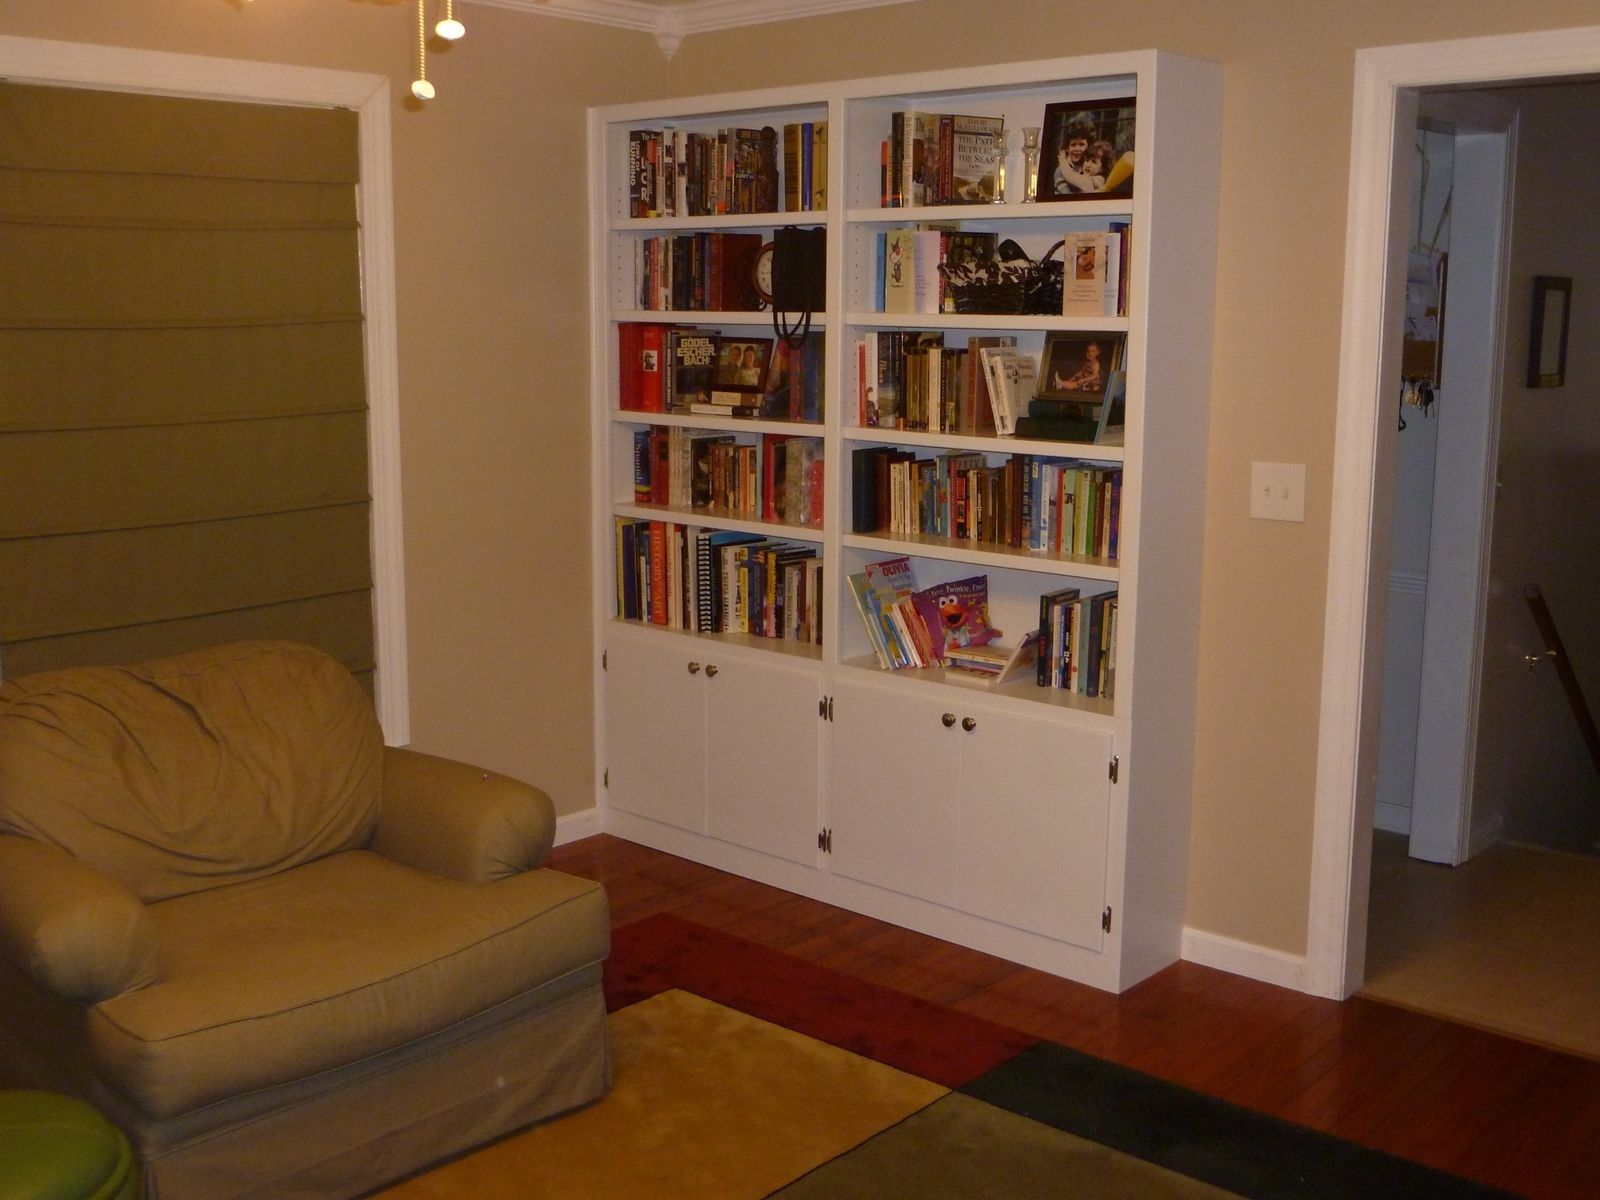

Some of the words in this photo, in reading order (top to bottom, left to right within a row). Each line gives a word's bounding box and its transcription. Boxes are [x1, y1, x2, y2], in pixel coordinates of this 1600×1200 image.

[634, 443, 643, 483] Spanish
[653, 530, 661, 582] HISTORY
[882, 562, 911, 577] OLIVIA
[654, 592, 662, 617] ART
